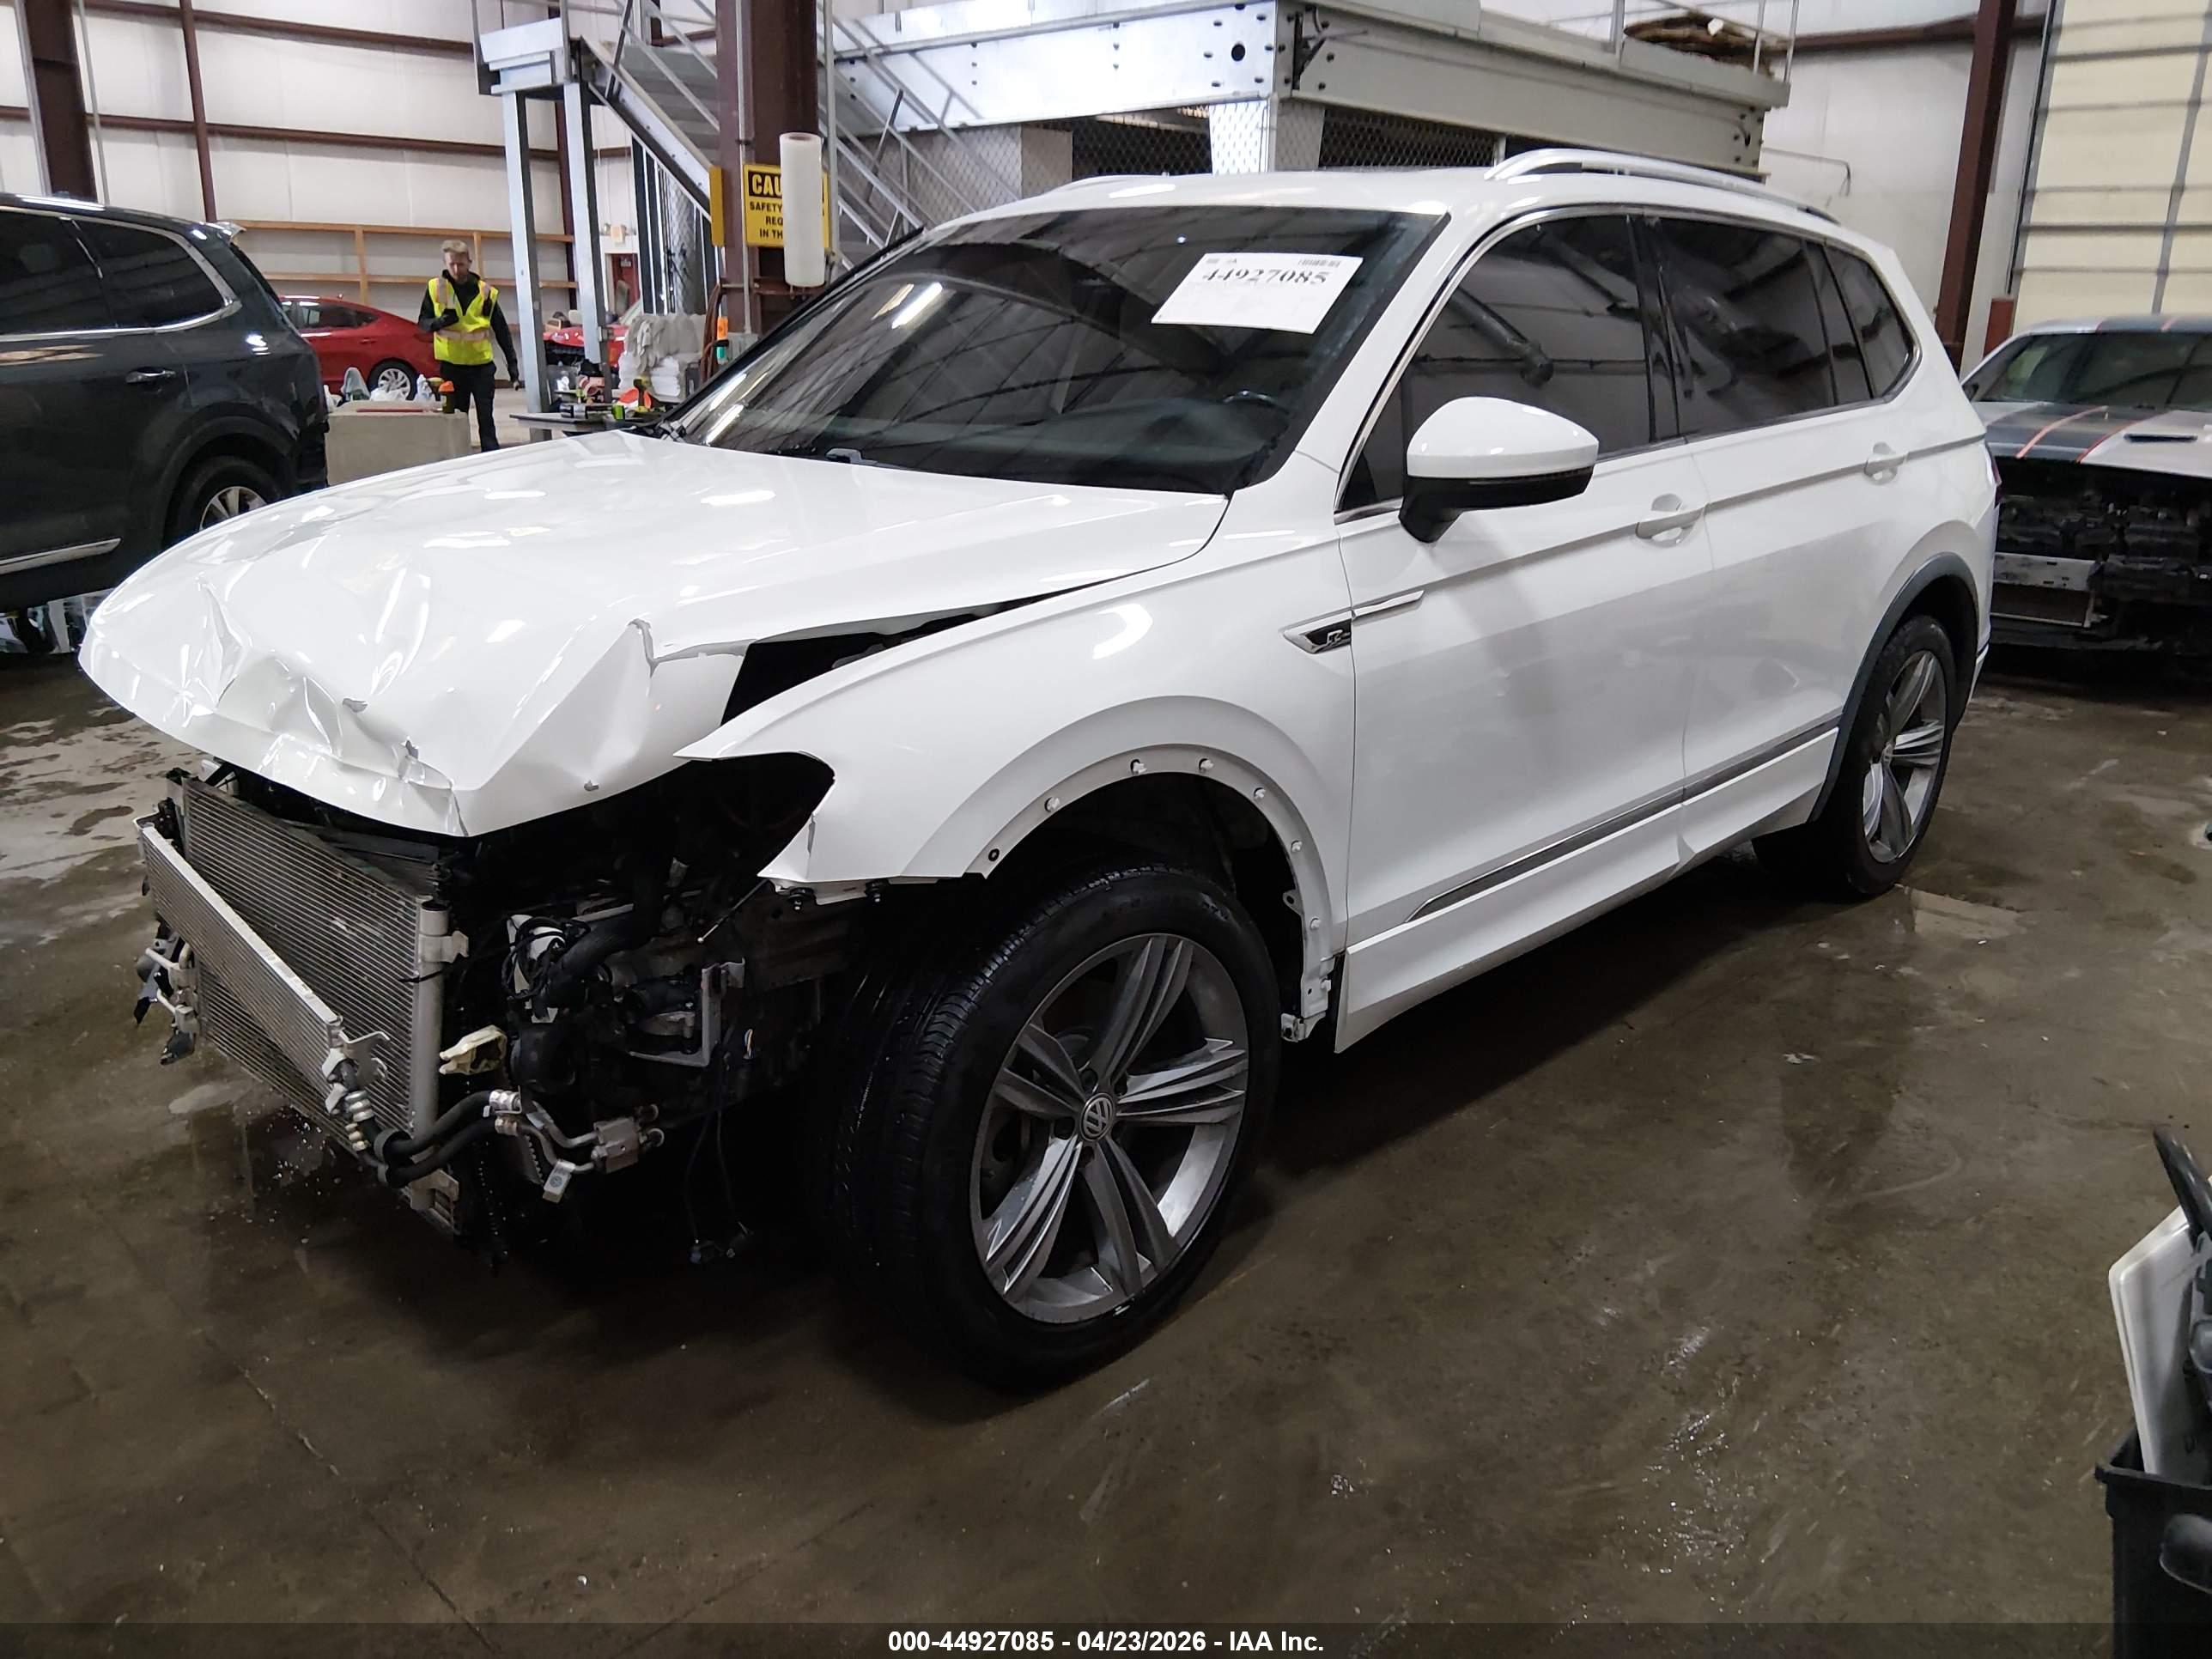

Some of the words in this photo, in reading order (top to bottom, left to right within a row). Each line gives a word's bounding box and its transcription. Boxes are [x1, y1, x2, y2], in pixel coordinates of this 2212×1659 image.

[750, 201, 782, 213] SAFETY
[759, 228, 769, 238] IN
[1202, 268, 1329, 284] 44927085
